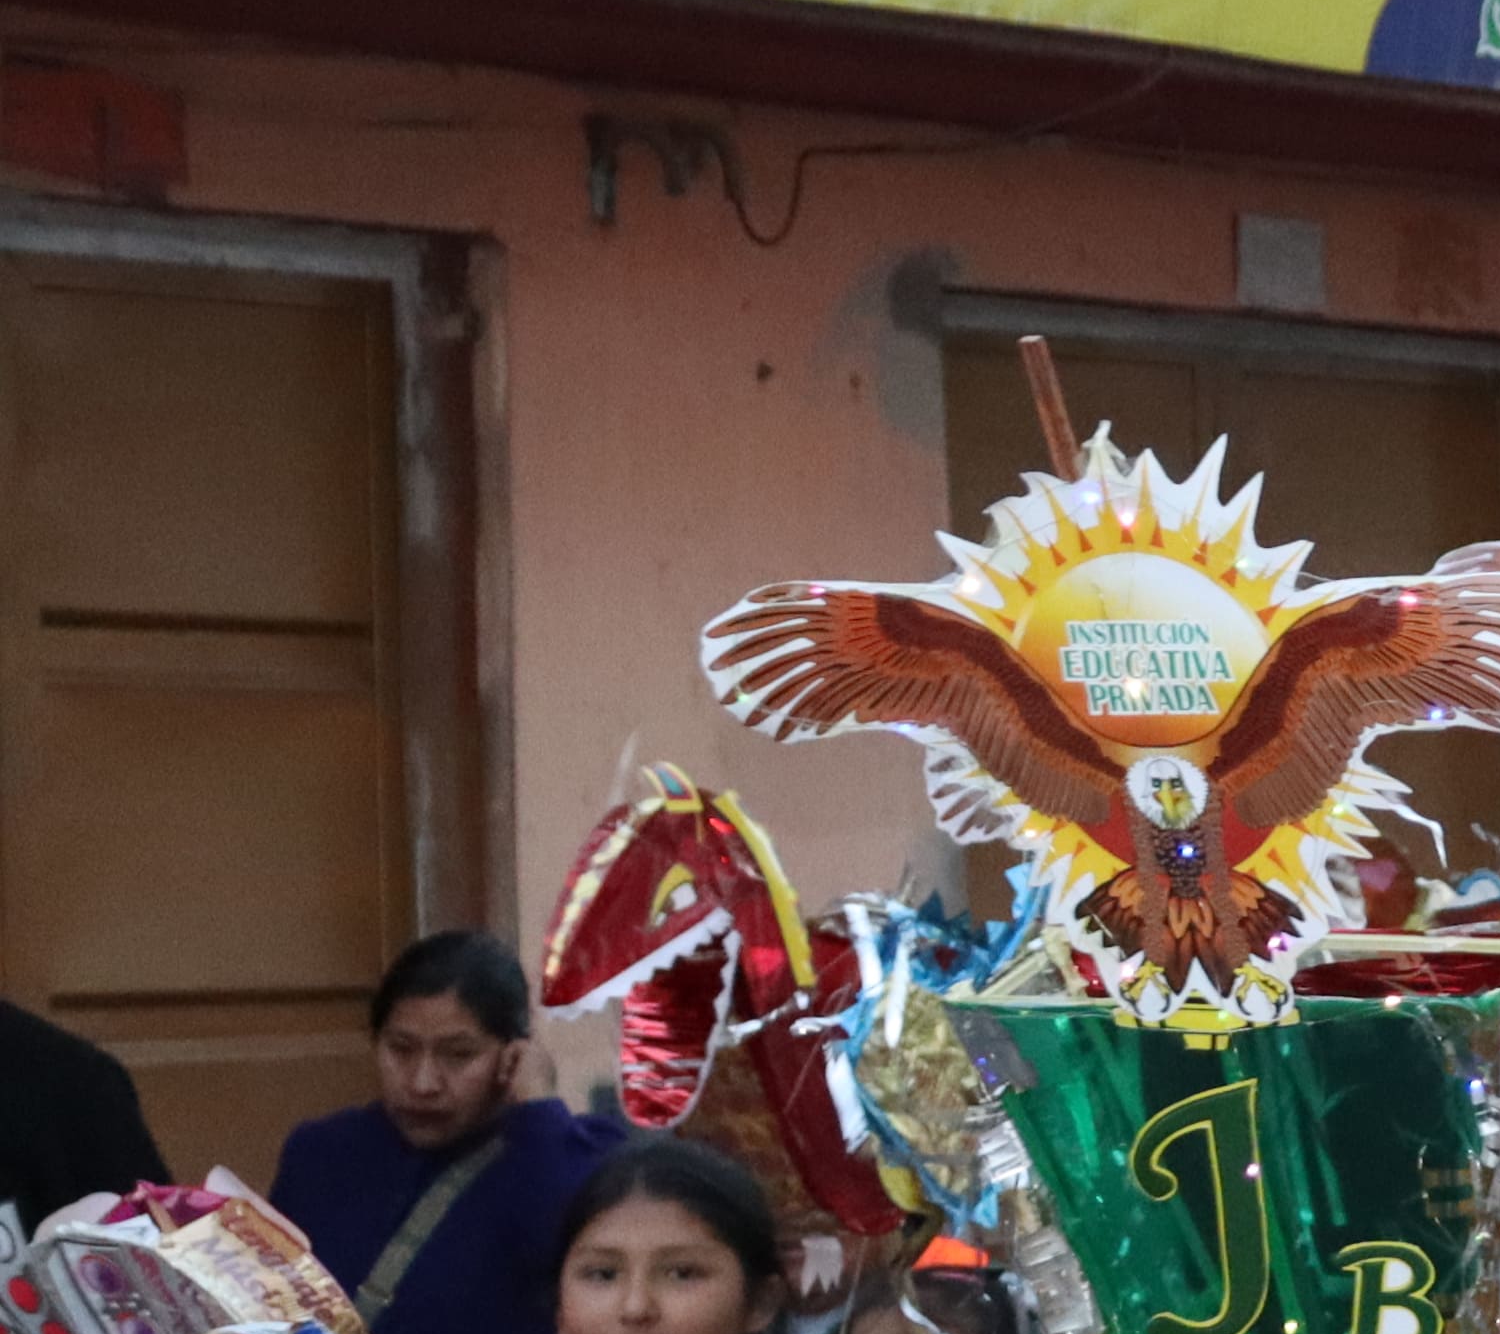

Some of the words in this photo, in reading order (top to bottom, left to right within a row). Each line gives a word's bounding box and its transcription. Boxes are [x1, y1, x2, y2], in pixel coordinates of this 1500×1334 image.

[1067, 616, 1211, 649] INSTITUCIÓN
[1060, 645, 1235, 685] EDUCATIVA
[1087, 680, 1220, 718] PRIVADA
